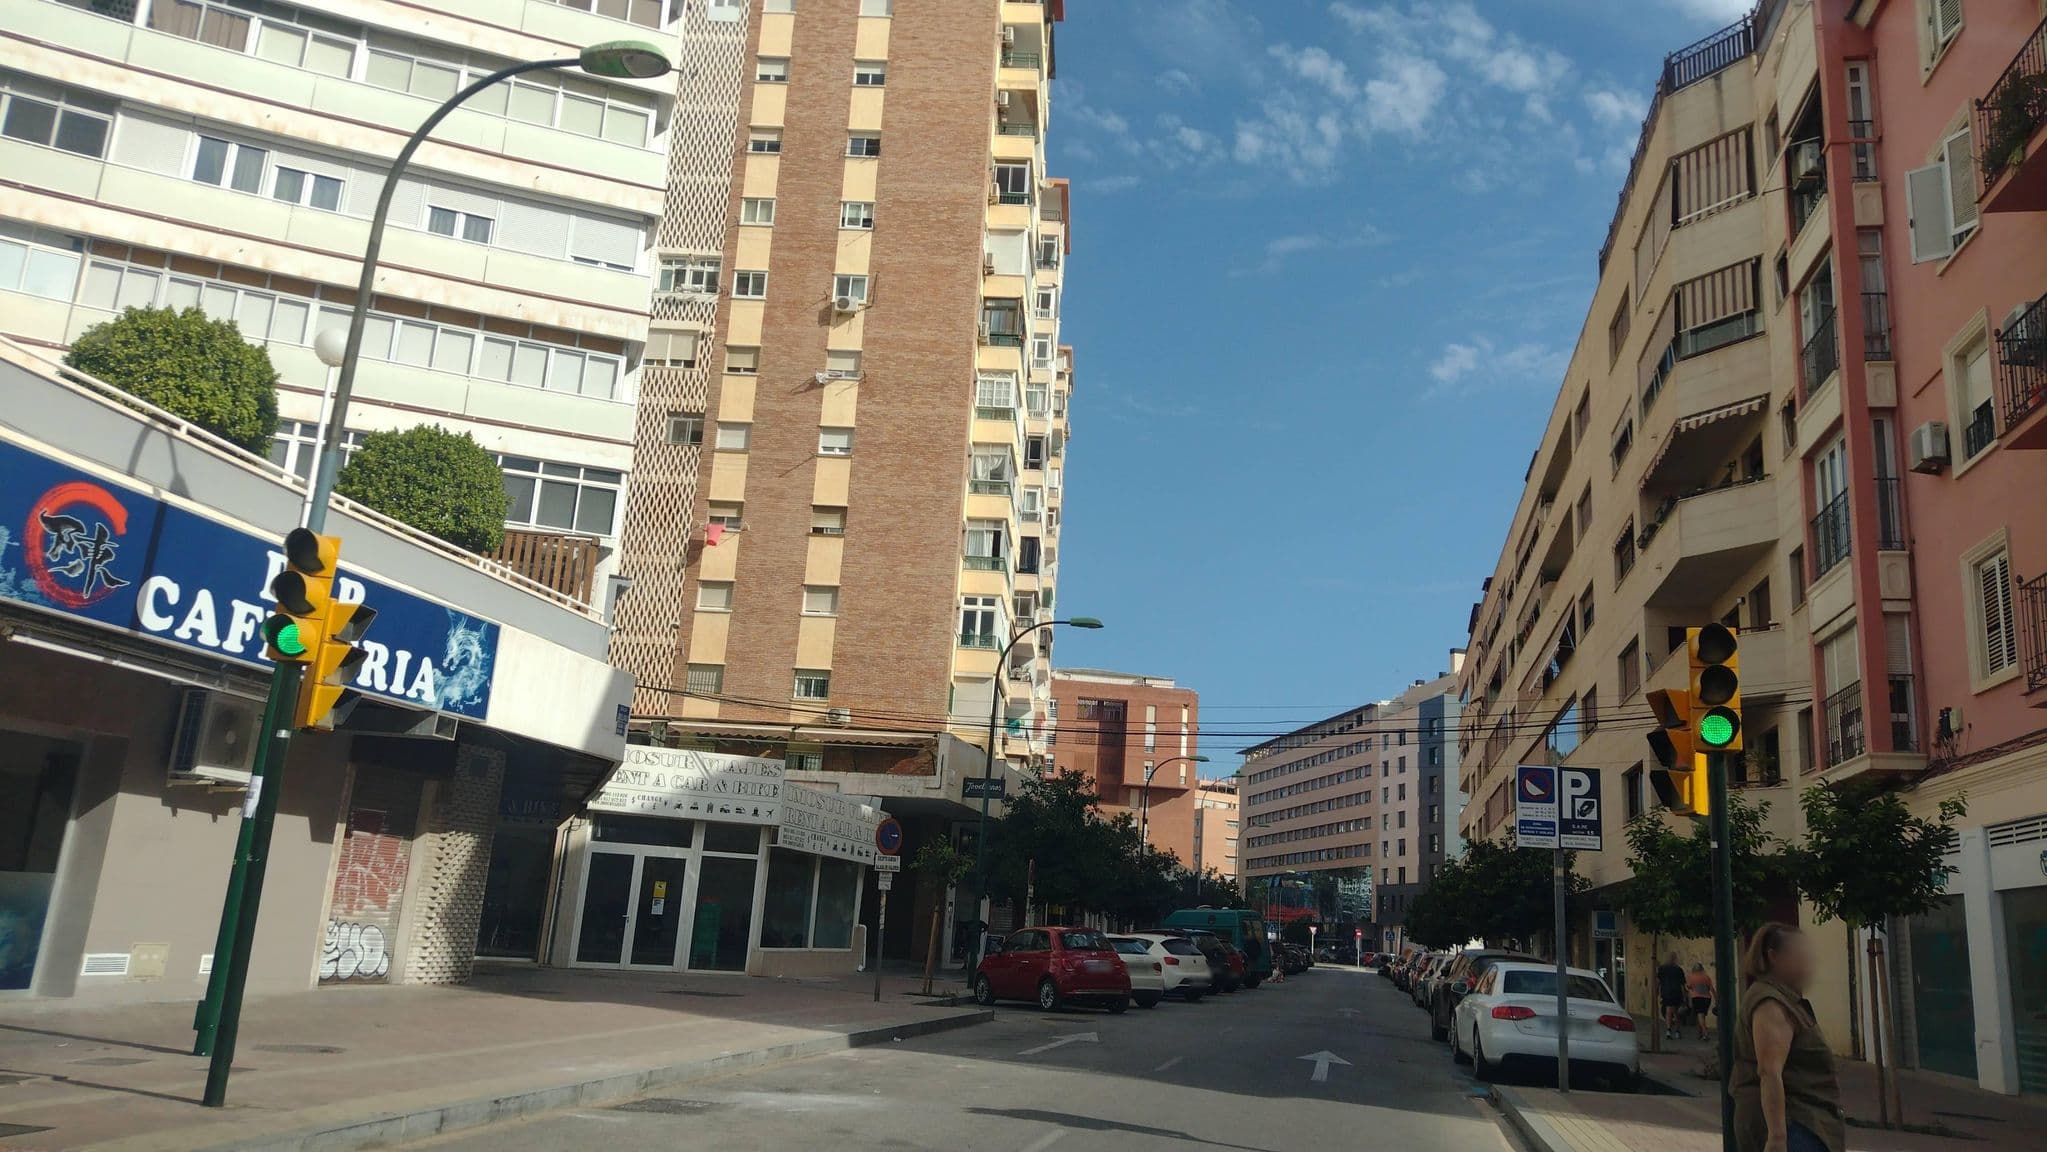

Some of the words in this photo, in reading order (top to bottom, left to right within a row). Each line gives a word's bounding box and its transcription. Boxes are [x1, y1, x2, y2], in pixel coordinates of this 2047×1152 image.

[259, 550, 366, 605] BR
[136, 575, 436, 702] CAFRIA
[703, 757, 782, 777] VIAJES
[611, 769, 650, 785] ENT
[653, 773, 666, 787] A
[670, 774, 709, 792] CAR
[714, 779, 728, 793] &
[733, 781, 779, 797] BIKE
[1562, 770, 1591, 819] P
[637, 794, 663, 803] CHANGE
[784, 807, 818, 829] RENT
[820, 816, 829, 832] A
